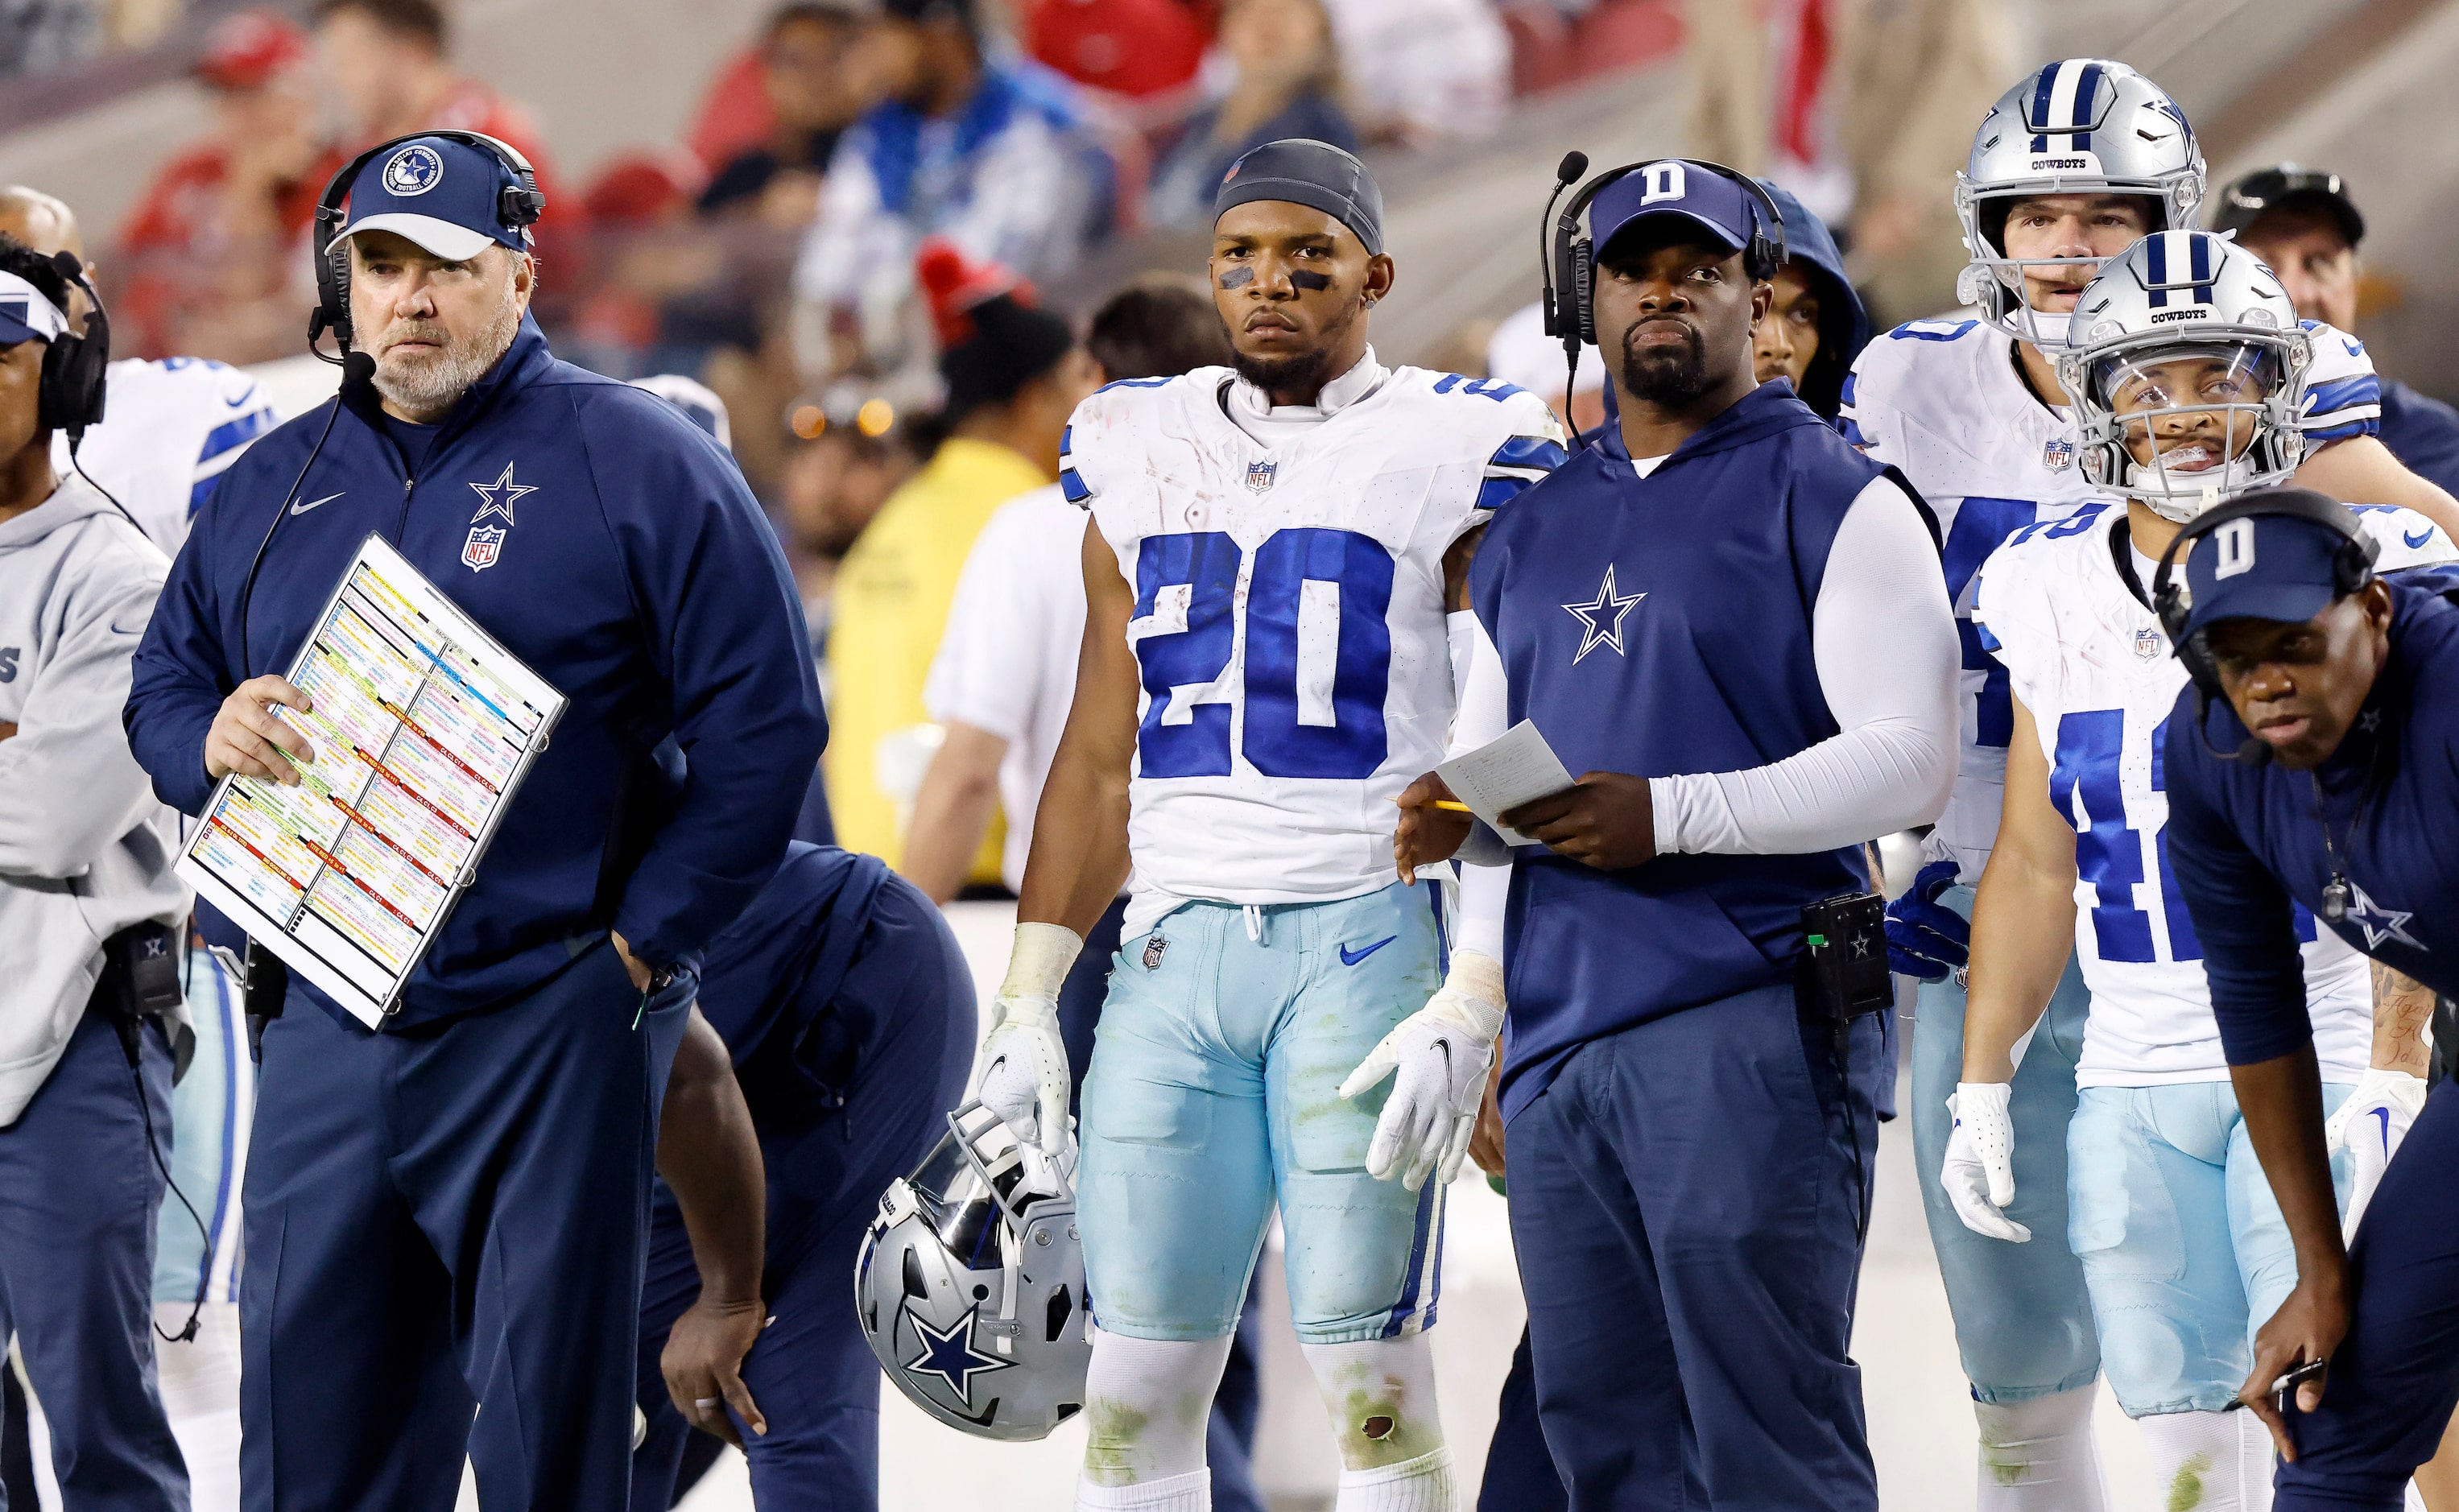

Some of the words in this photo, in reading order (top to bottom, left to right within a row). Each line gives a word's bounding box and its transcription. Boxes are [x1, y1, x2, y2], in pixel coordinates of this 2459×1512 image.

[395, 150, 413, 165] DALLAS
[415, 149, 436, 165] COWBOYS
[2031, 159, 2086, 171] COWBOYS
[395, 183, 424, 192] FOOTBALL
[424, 170, 437, 186] LEAGUE
[1640, 163, 1685, 206] D
[2151, 309, 2207, 324] COWBOYS
[2048, 451, 2068, 465] NFL
[1249, 473, 1268, 487] NFL
[468, 543, 493, 563] NFL
[2215, 517, 2255, 580] D
[434, 628, 453, 645] BACKED
[450, 642, 458, 650] UP
[2138, 639, 2156, 654] NFL
[416, 643, 430, 655] LOGO
[428, 653, 440, 664] ZONE
[1130, 527, 1396, 779] 20
[407, 659, 421, 671] GOLD
[418, 667, 432, 680] ZONE
[384, 702, 398, 714] HIGH
[395, 710, 406, 721] RED
[358, 750, 370, 761] MID
[366, 757, 378, 768] RED
[334, 799, 347, 811] LOW
[344, 807, 356, 818] RED
[308, 842, 320, 853] TITE
[317, 849, 329, 860] RED
[267, 861, 288, 878] GOALLINE
